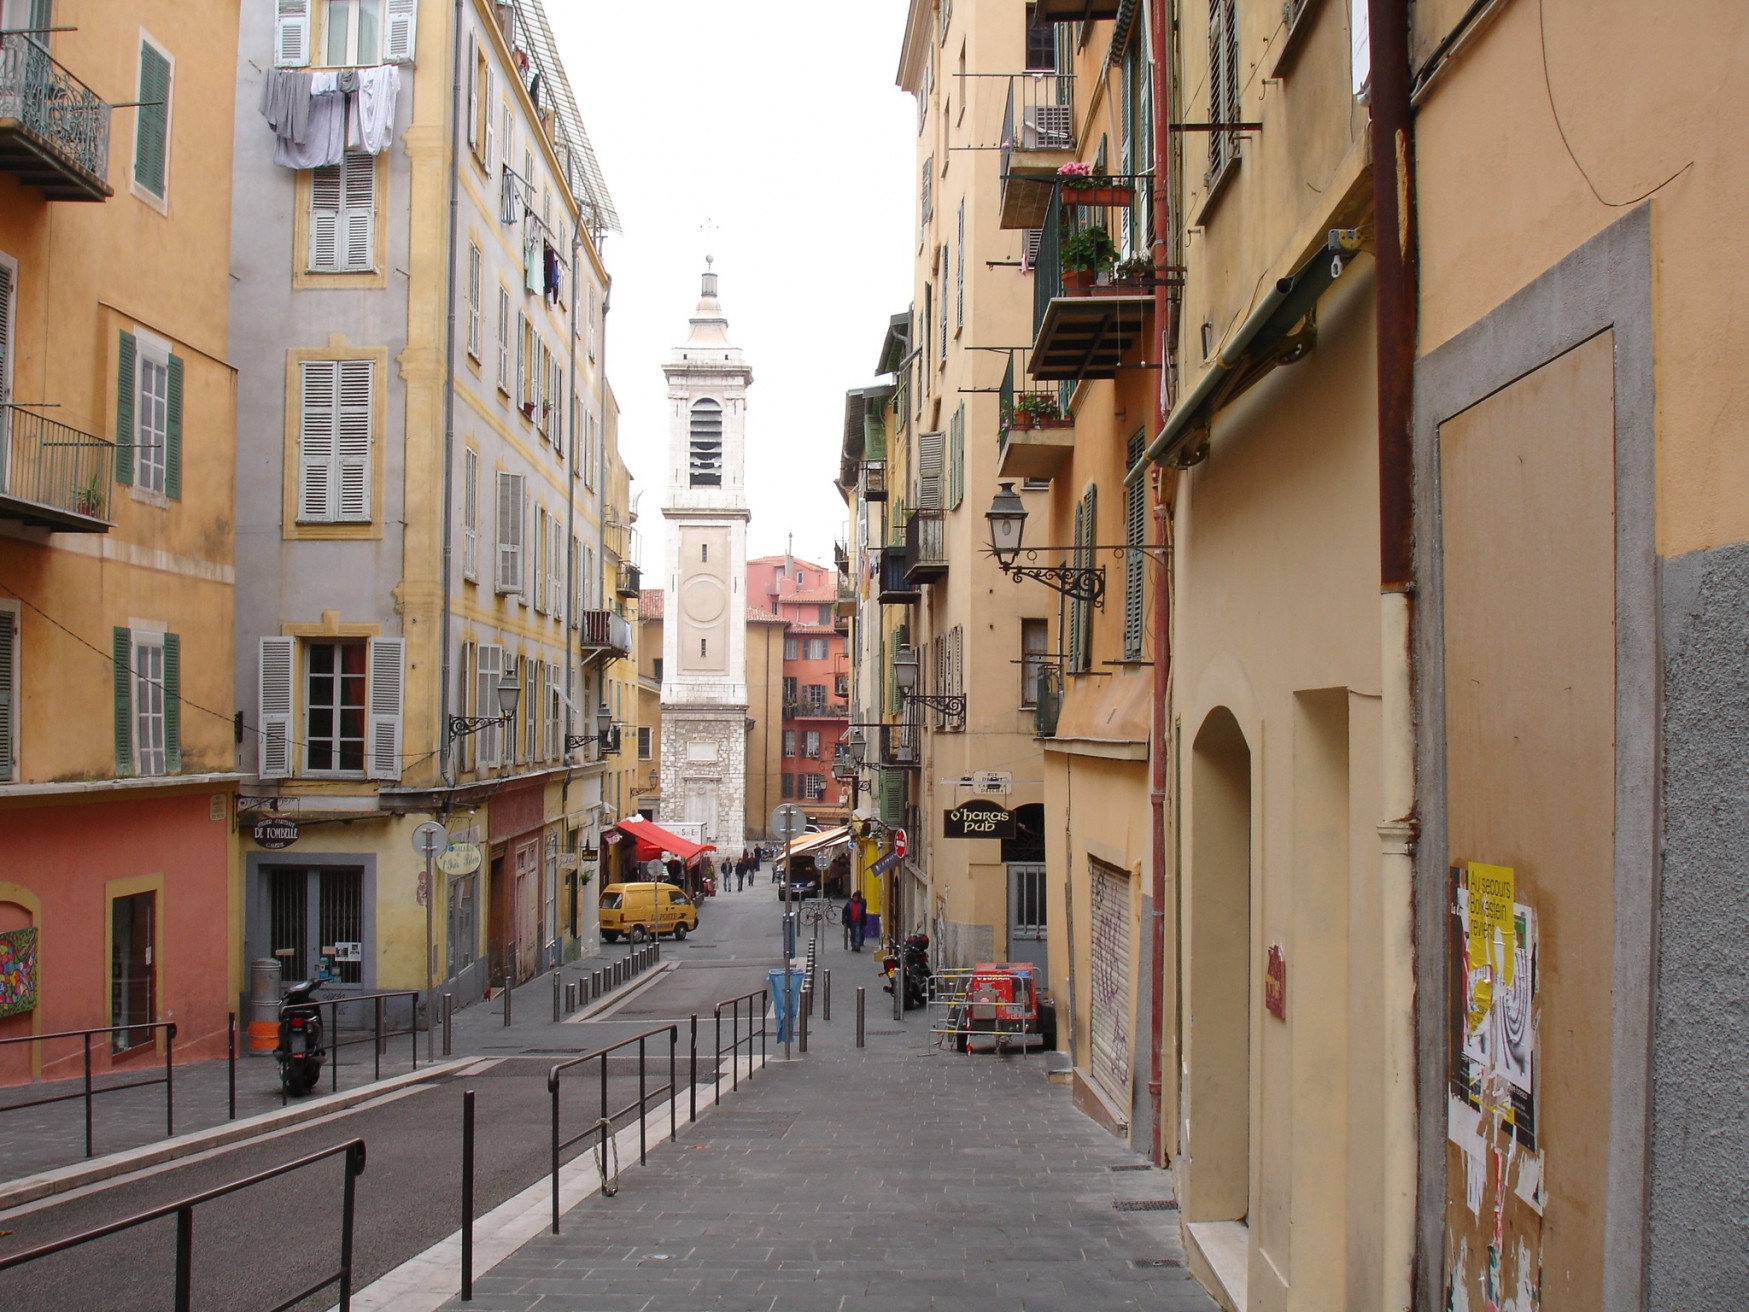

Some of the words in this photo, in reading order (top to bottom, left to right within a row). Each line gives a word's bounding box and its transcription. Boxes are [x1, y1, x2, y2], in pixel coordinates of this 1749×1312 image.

[254, 827, 264, 839] DE
[1470, 870, 1480, 893] Au
[1481, 877, 1512, 900] secours
